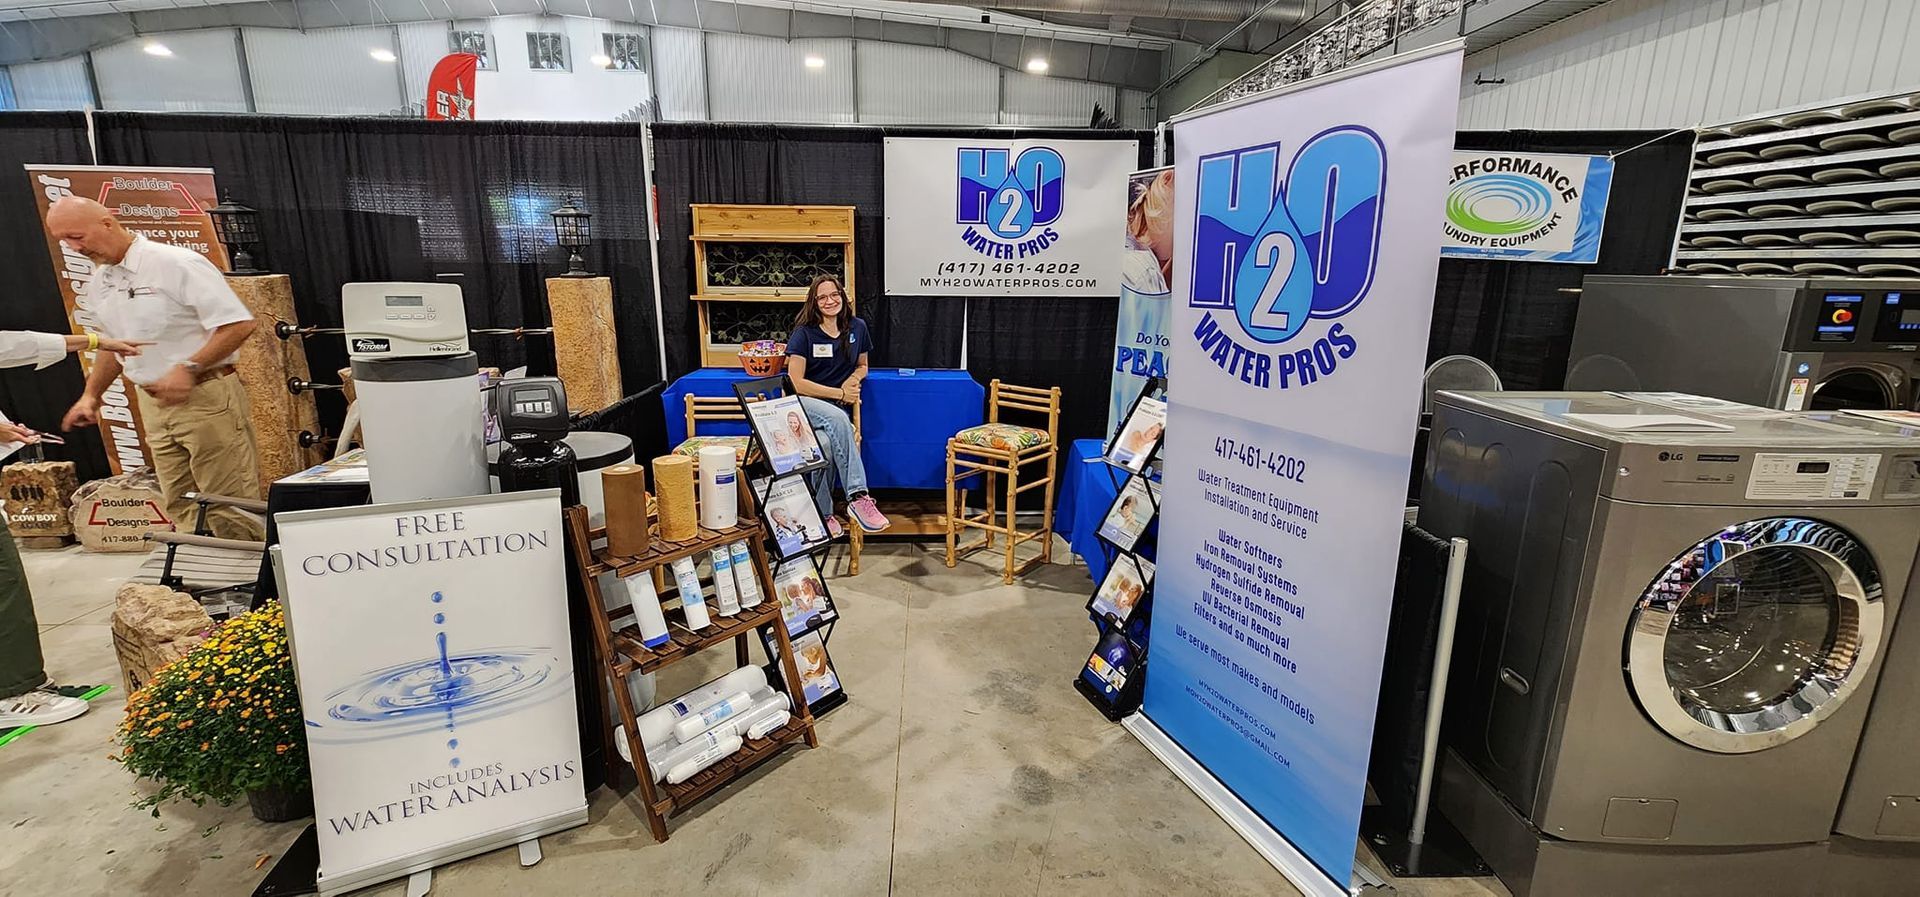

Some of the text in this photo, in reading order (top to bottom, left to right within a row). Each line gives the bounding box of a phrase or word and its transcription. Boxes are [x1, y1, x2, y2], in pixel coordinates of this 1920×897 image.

[113, 177, 172, 190] Boulder
[957, 146, 1066, 232] H2O
[1449, 157, 1578, 203] RFORMANCE
[120, 204, 179, 219] Designs
[168, 229, 200, 240] your
[1189, 124, 1387, 331] H2O
[1443, 212, 1562, 247] UNDRY EQUIPMENT
[961, 225, 1060, 260] WATER PROS
[920, 278, 1097, 288] MYH2OWATERPROS.COM
[938, 262, 1080, 276] (417) 461-4202
[1116, 345, 1169, 378] PEA
[1136, 332, 1170, 347] Do Yo
[1193, 310, 1357, 389] WATER PROS
[1215, 436, 1305, 483] 417-461-4202
[101, 498, 146, 507] Boulder
[1198, 468, 1319, 523] Water Treatment Equipment
[1204, 488, 1307, 539] Installation and Service
[106, 518, 150, 528] Designs
[395, 511, 465, 537] FREE
[302, 530, 549, 577] CONSULTATION
[1204, 540, 1297, 595] Iron Removal Systems
[1218, 528, 1282, 569] Water Softners
[1195, 553, 1304, 619] Hydrogen Sulfide Removal
[1211, 578, 1281, 626] Reverse Osmosis
[1194, 602, 1297, 673] Filters and so much more
[1202, 590, 1289, 650] UV Bacterial Removal
[1175, 624, 1314, 724] We serve most makes and models
[328, 759, 576, 836] WATER ANALYSIS
[409, 762, 503, 795] INCLUDES
